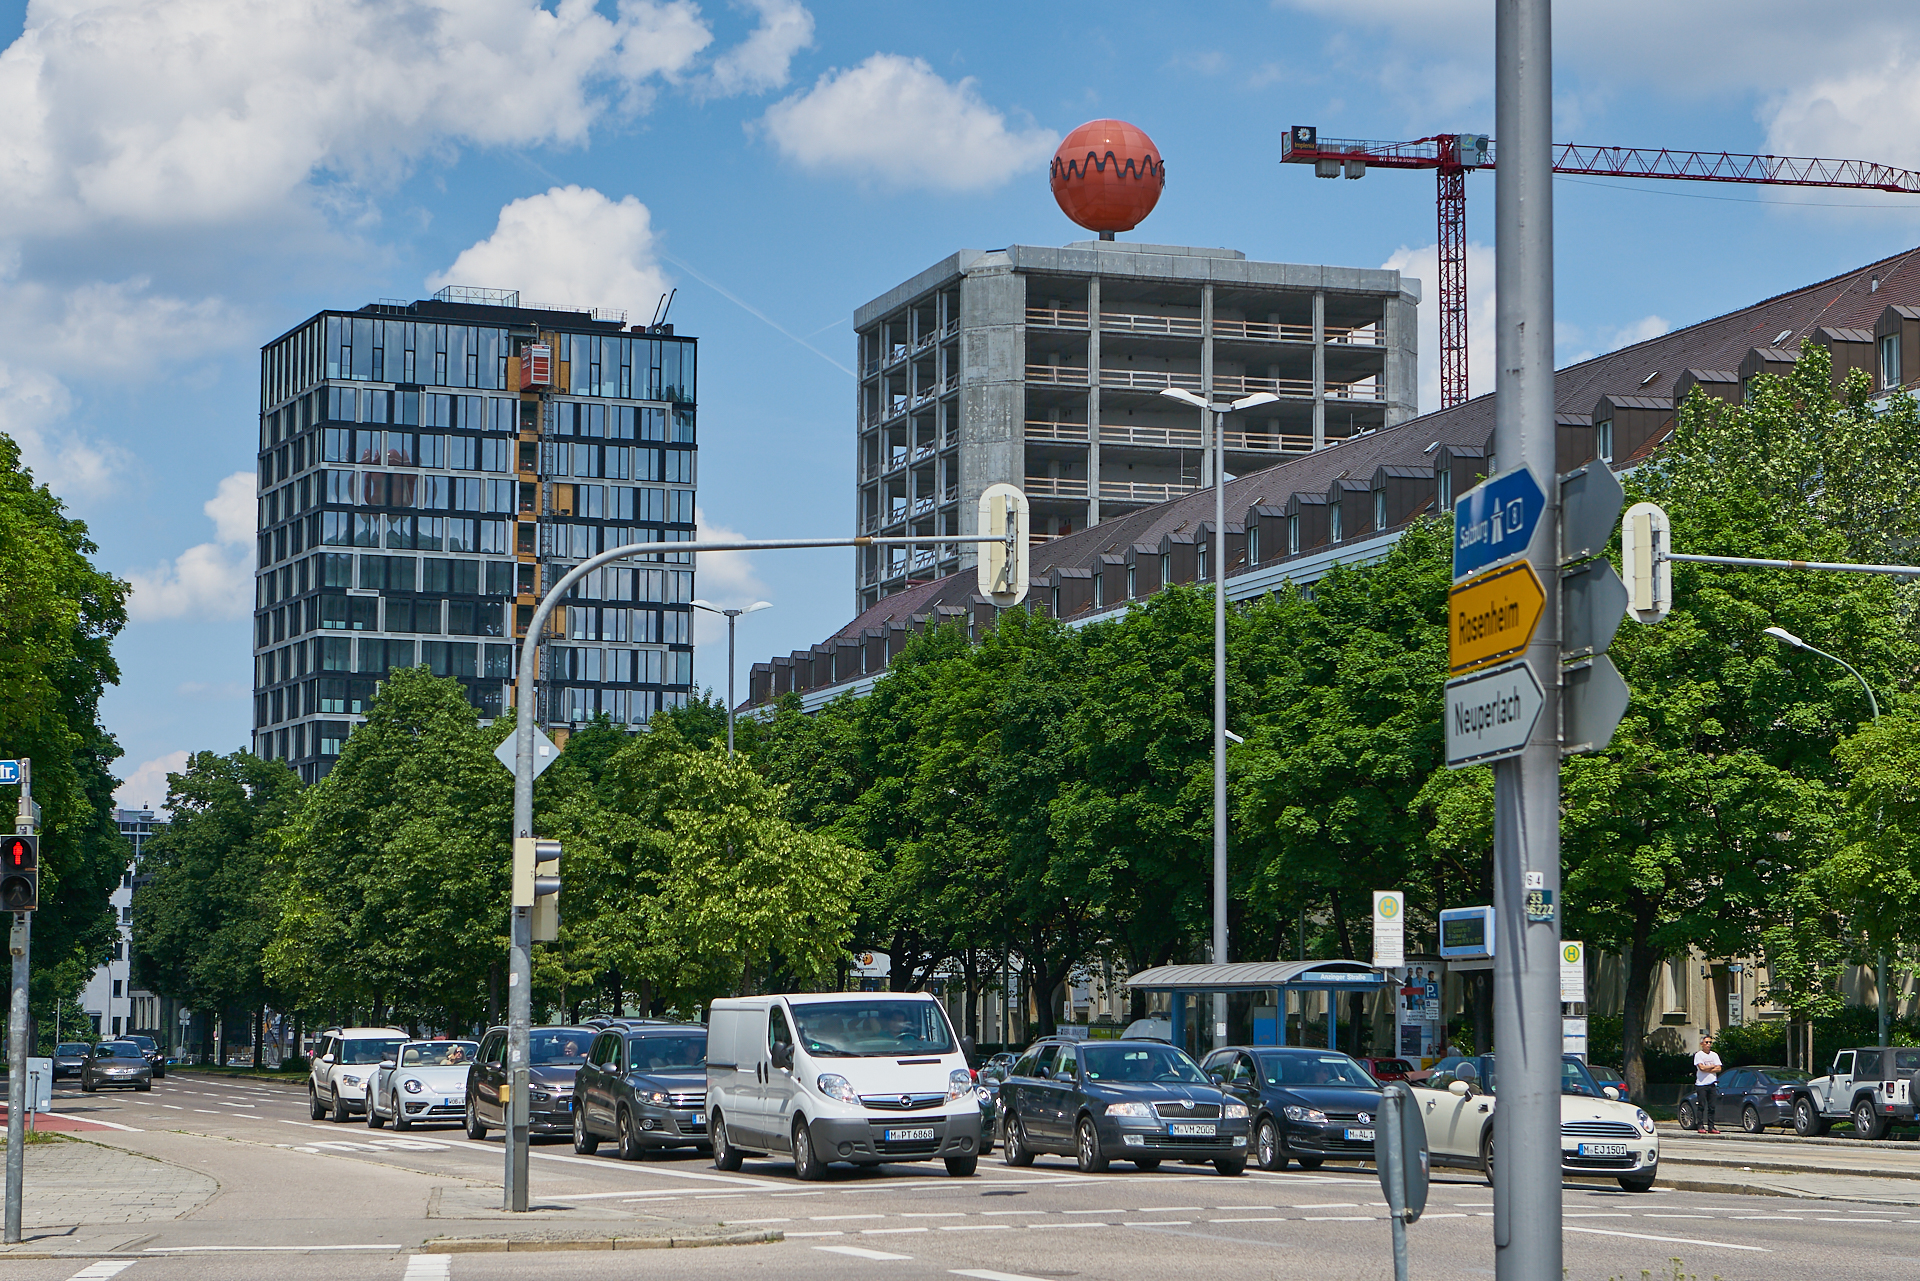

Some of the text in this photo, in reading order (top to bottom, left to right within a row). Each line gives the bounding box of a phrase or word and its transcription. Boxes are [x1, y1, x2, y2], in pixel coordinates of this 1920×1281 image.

[1460, 520, 1488, 549] Salzburg
[1459, 595, 1519, 646] Rosenheim
[1455, 685, 1521, 740] Neuperlach
[1529, 893, 1543, 904] 33
[1320, 973, 1345, 981] Anzinger
[1426, 984, 1435, 997] P
